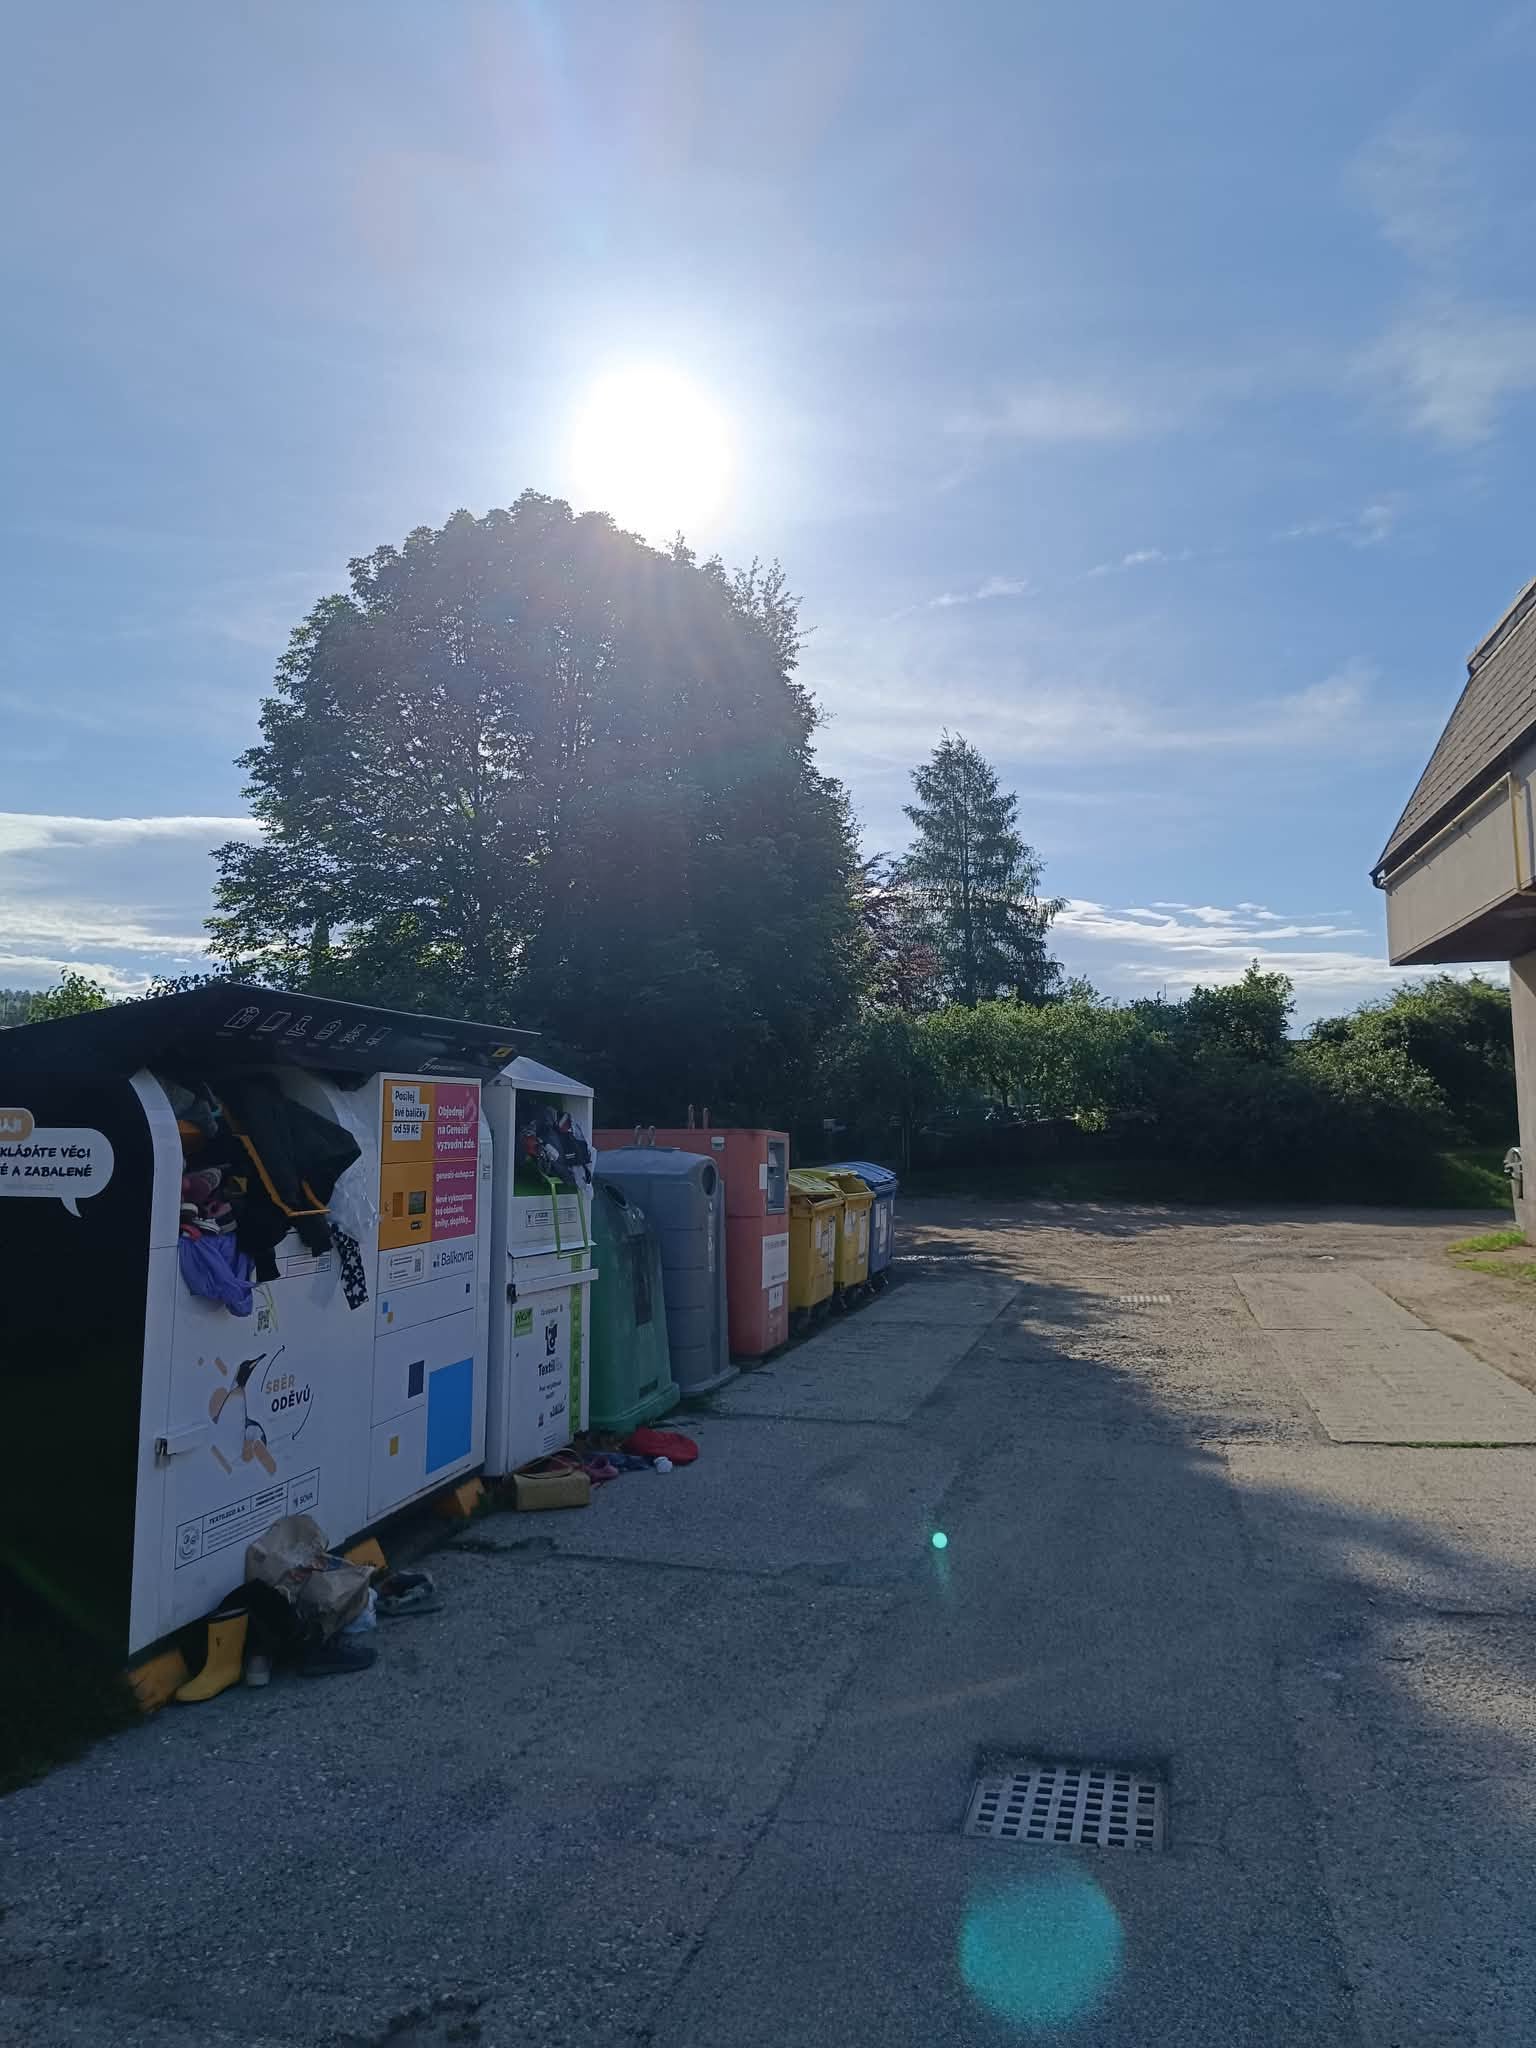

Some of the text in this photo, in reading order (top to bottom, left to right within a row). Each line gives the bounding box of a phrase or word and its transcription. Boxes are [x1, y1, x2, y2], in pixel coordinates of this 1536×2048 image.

[393, 1123, 402, 1133] od
[12, 1166, 21, 1176] A
[24, 1164, 92, 1177] ZABALENÉ
[441, 1249, 474, 1267] Balíkovna
